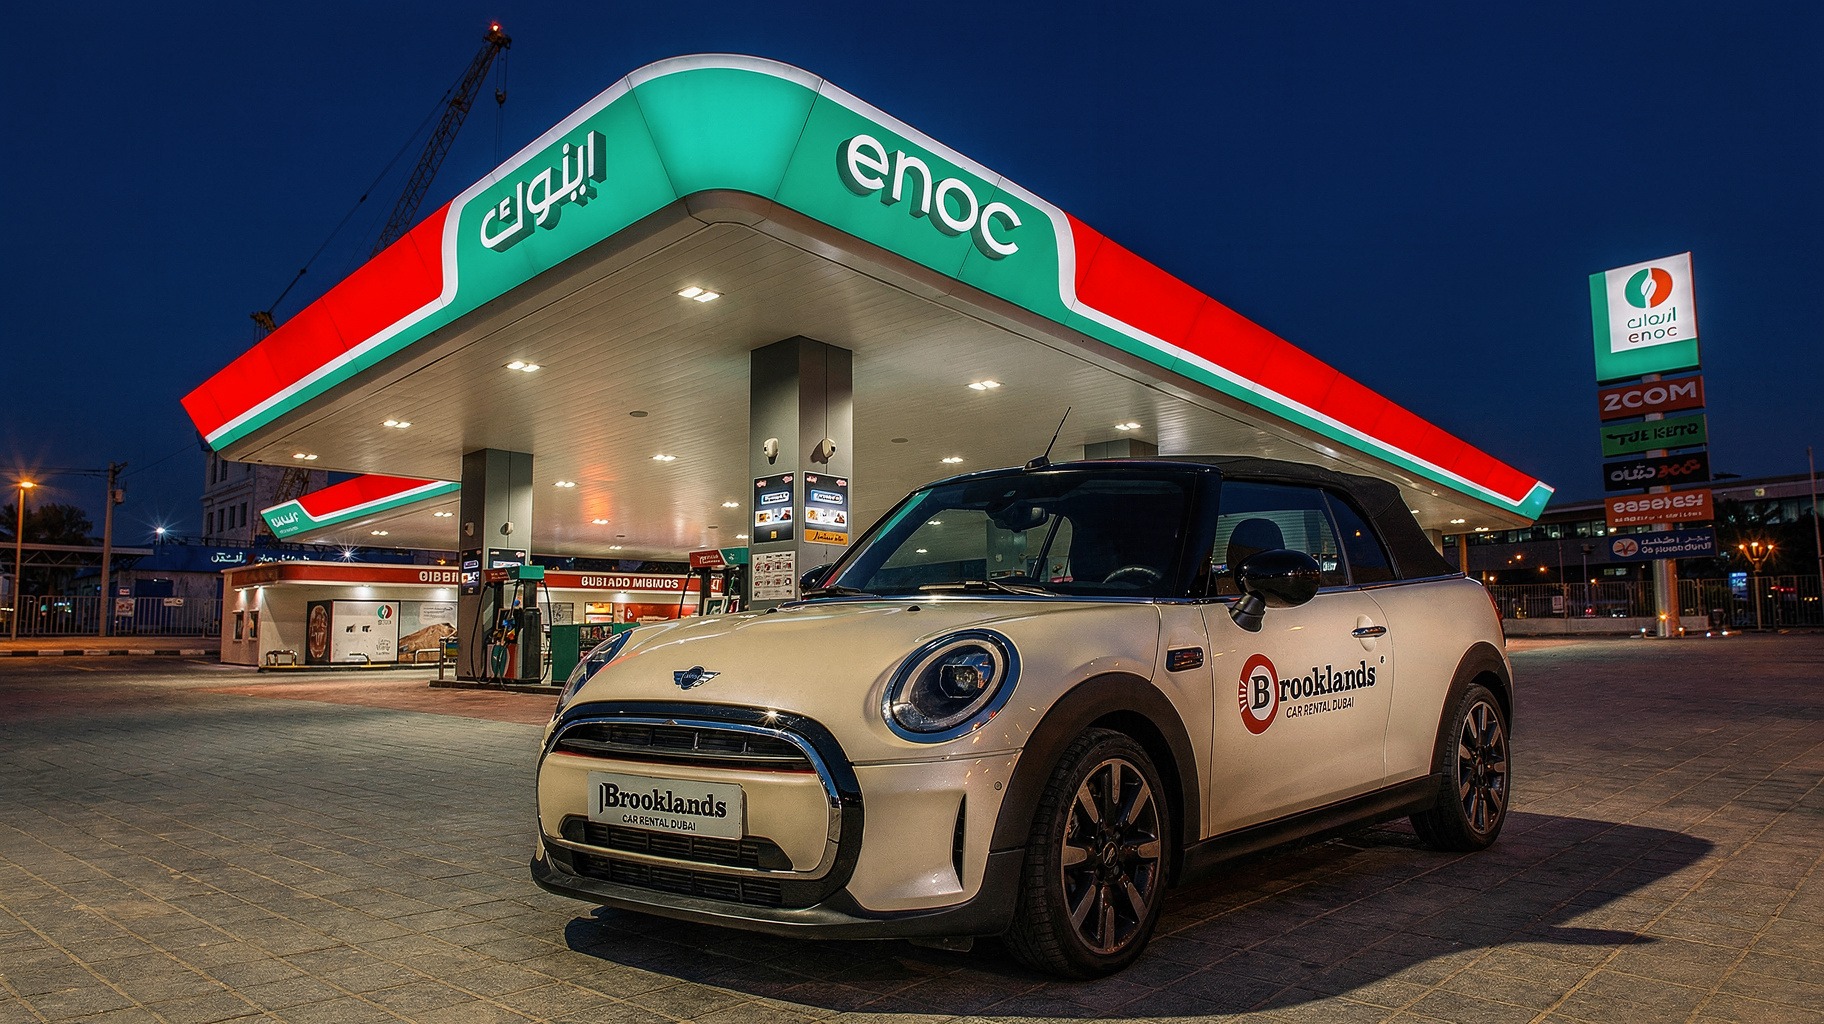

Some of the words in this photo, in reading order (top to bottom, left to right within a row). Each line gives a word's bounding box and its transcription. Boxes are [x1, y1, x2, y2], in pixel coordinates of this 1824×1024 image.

[842, 133, 1022, 257] enoc
[1628, 326, 1677, 343] enoc
[1251, 660, 1376, 711] Brooklands
[1286, 706, 1303, 719] CAR
[1304, 700, 1331, 716] RENTAL
[1332, 697, 1355, 711] DUBAI
[600, 782, 728, 818] Brooklands
[622, 814, 638, 824] CAR
[639, 816, 670, 828] RENTAL
[670, 820, 697, 831] DUBAI
